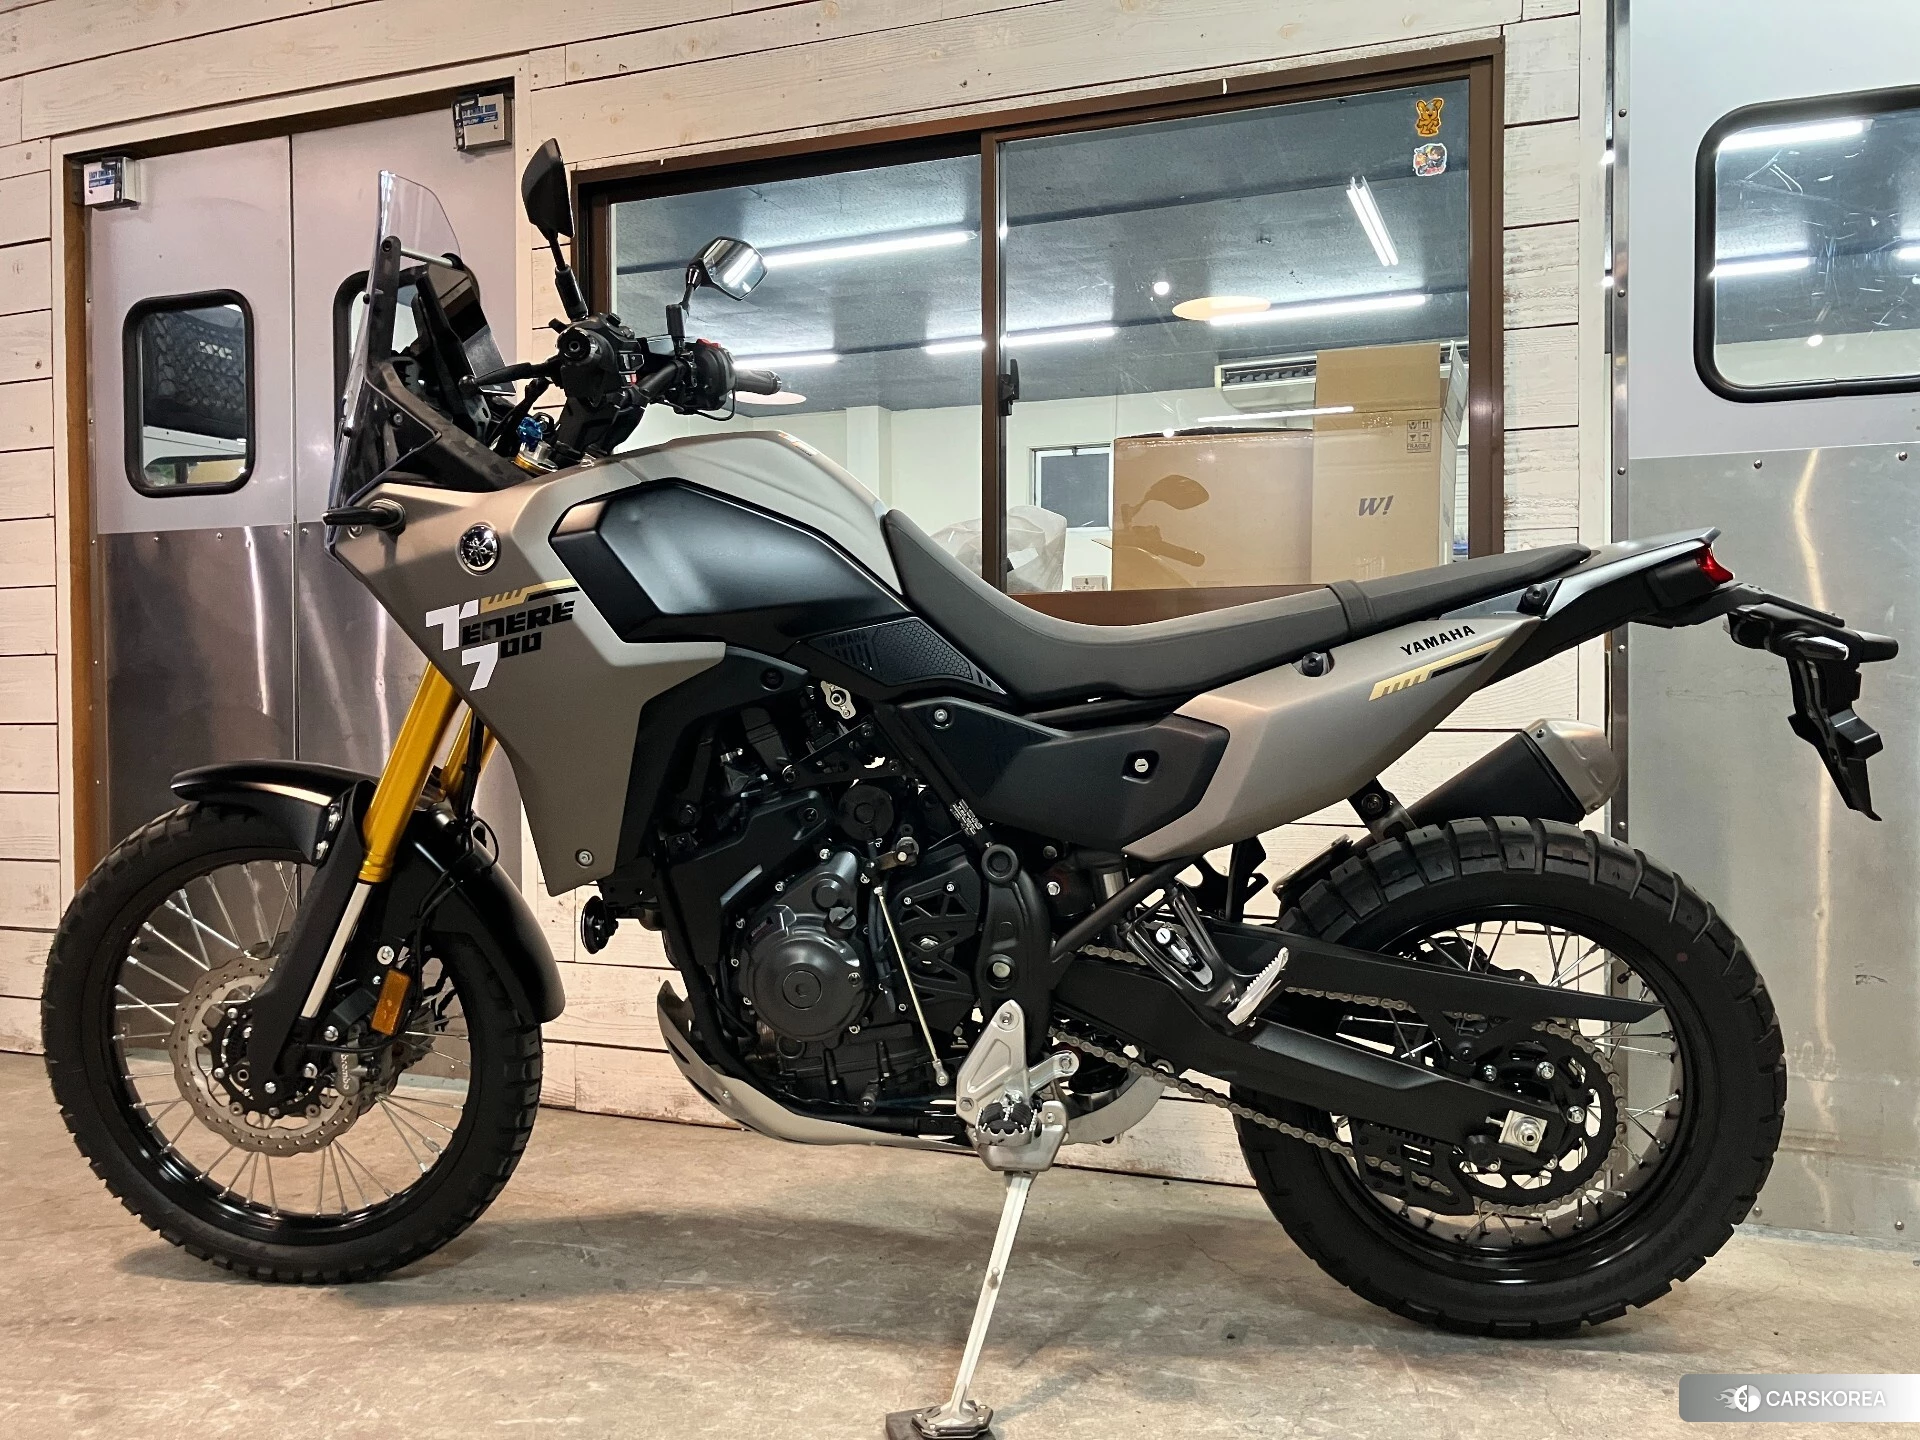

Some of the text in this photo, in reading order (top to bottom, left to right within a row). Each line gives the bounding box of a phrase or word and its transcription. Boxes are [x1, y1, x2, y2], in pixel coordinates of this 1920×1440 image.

[1359, 495, 1393, 516] W!
[1400, 625, 1475, 655] YAMAHA
[461, 632, 542, 691] 700
[341, 1054, 350, 1090] brembo
